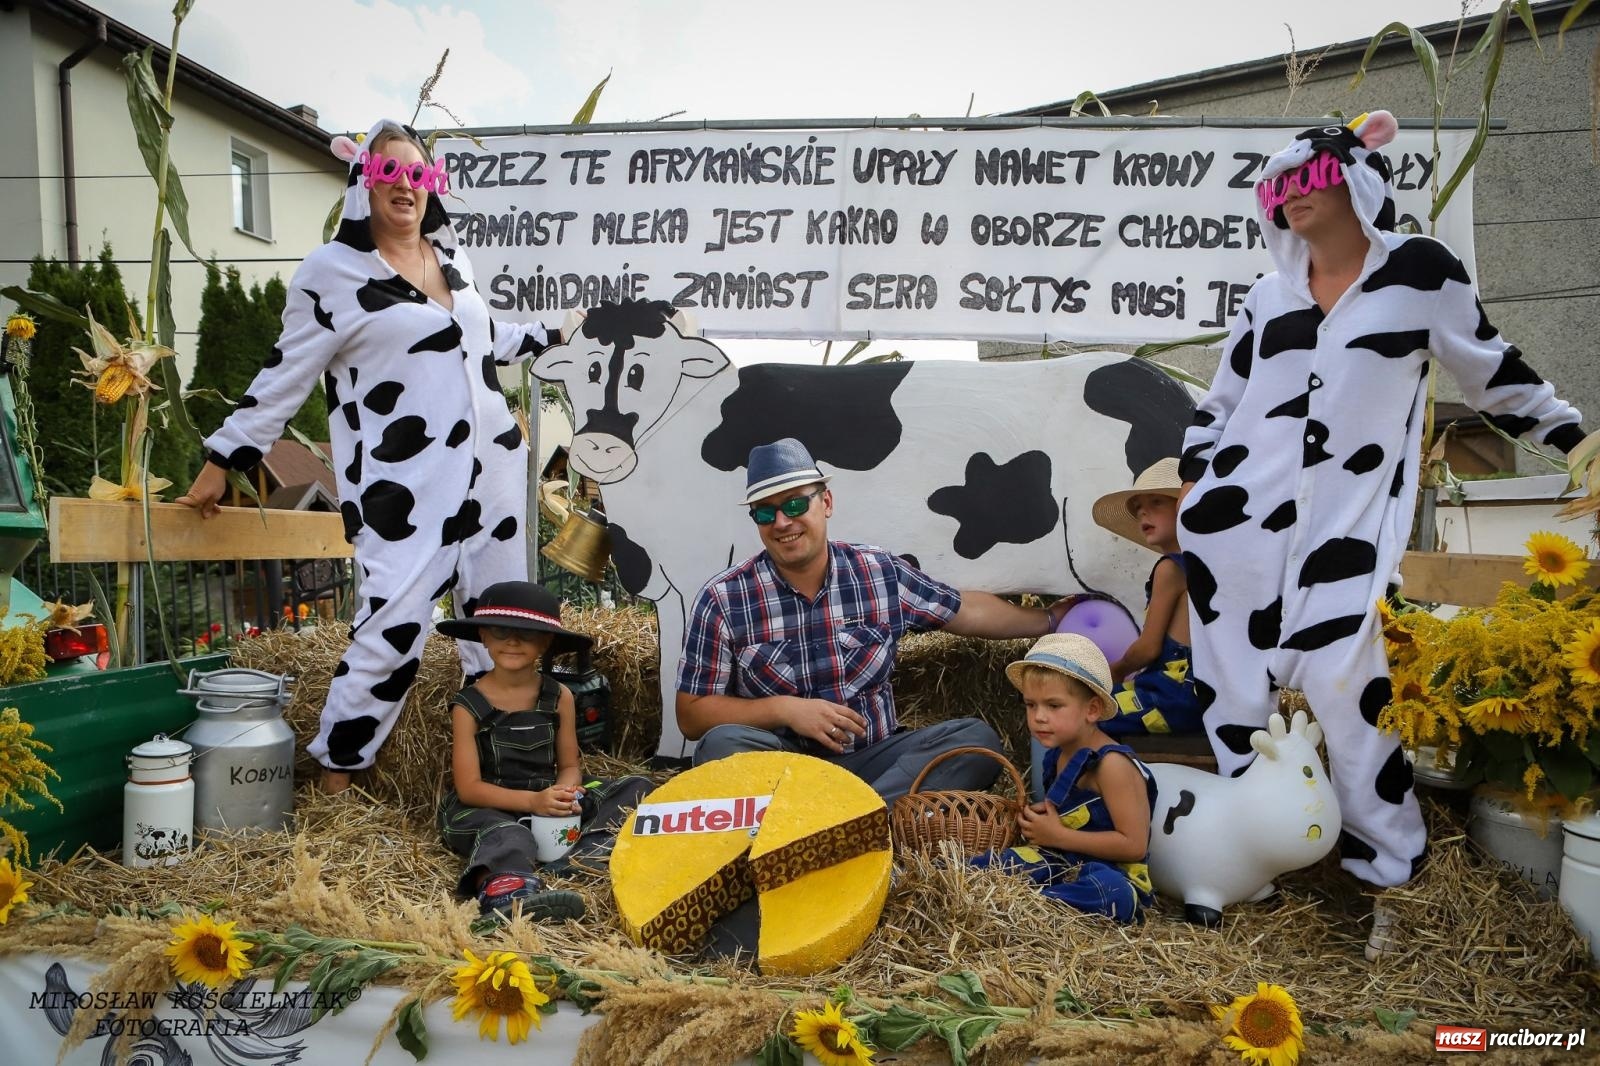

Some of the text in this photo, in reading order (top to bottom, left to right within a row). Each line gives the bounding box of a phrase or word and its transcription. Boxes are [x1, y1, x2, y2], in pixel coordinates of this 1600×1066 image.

[445, 151, 547, 189] PRZEZ
[560, 149, 611, 185] TE
[628, 135, 837, 186] AFRYKAŃSKIE
[853, 146, 958, 186] UPAŁY
[974, 147, 1100, 186] NAWET
[1112, 149, 1215, 188] KROWY
[450, 205, 578, 248] ZAMIAST
[591, 207, 689, 246] MLEKA
[703, 208, 794, 253] JEST
[805, 205, 898, 245] KAKAO
[920, 211, 949, 246] W
[970, 212, 1106, 248] OBORZE
[489, 262, 650, 312] ŚNIADANIE
[672, 265, 829, 310] ZAMIAST
[846, 272, 938, 310] SERA
[959, 272, 1091, 314] SOŁTYS
[230, 765, 291, 785] KOBYLA
